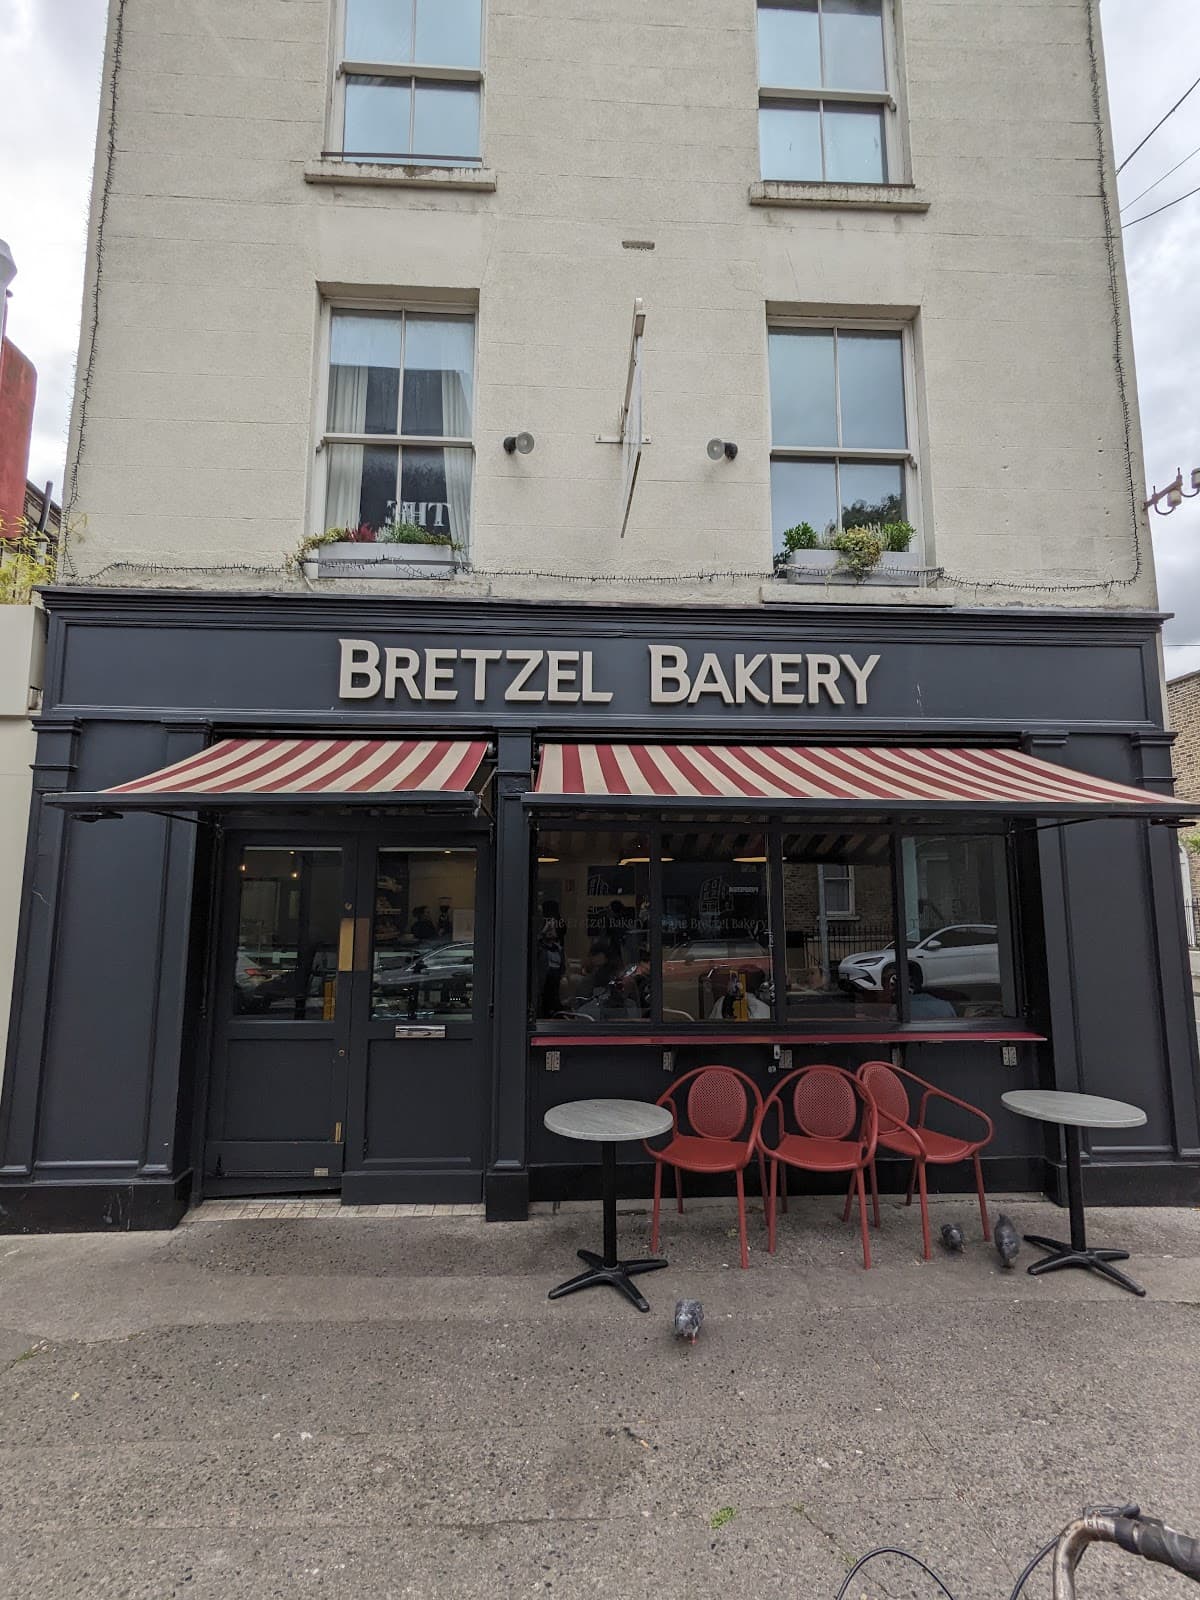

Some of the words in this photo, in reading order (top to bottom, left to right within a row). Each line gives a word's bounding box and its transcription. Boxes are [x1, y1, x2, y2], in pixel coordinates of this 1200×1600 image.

[338, 638, 613, 703] BRETZEL
[647, 644, 881, 705] BAKERY
[609, 917, 644, 929] Bakery
[731, 917, 768, 929] Bakery
